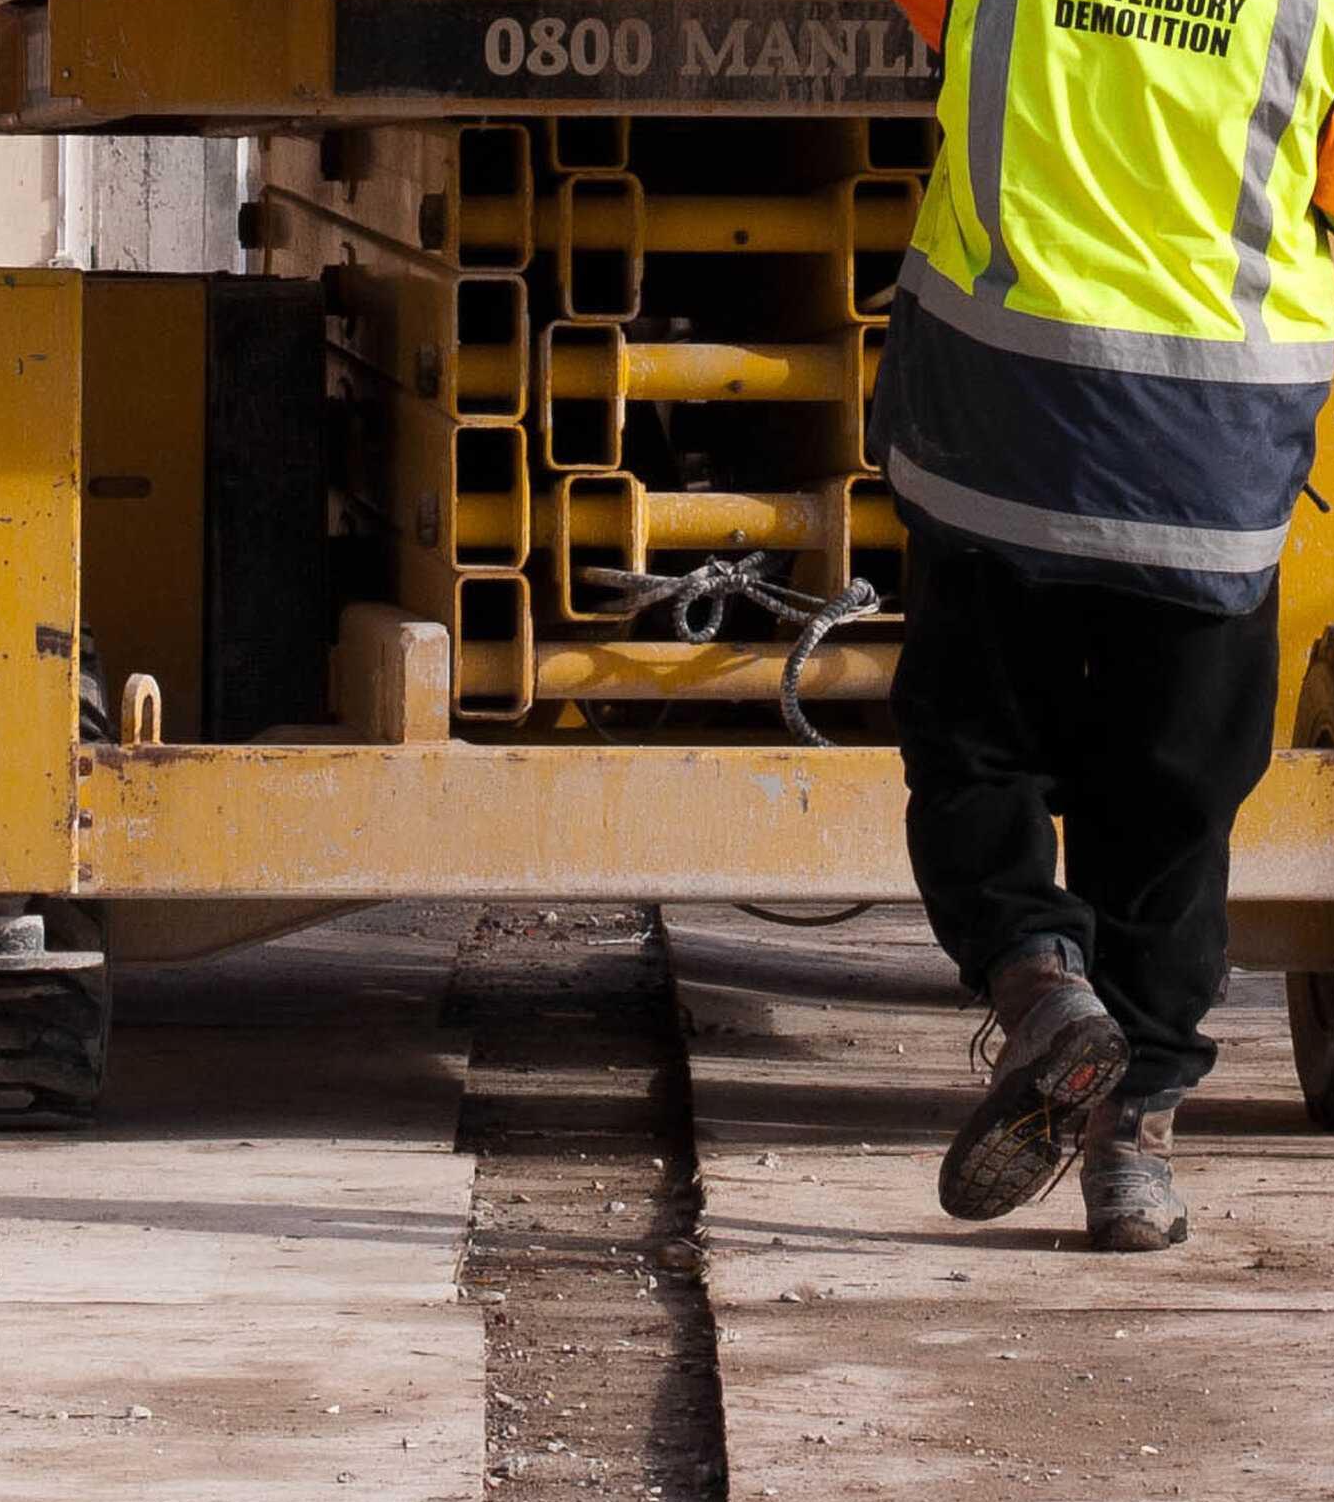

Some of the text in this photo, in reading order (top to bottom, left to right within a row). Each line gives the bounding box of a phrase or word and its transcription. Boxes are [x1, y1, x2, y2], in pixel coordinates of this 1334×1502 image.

[485, 17, 939, 77] 0800 MANLI
[1055, 0, 1231, 57] DEMOLITION
